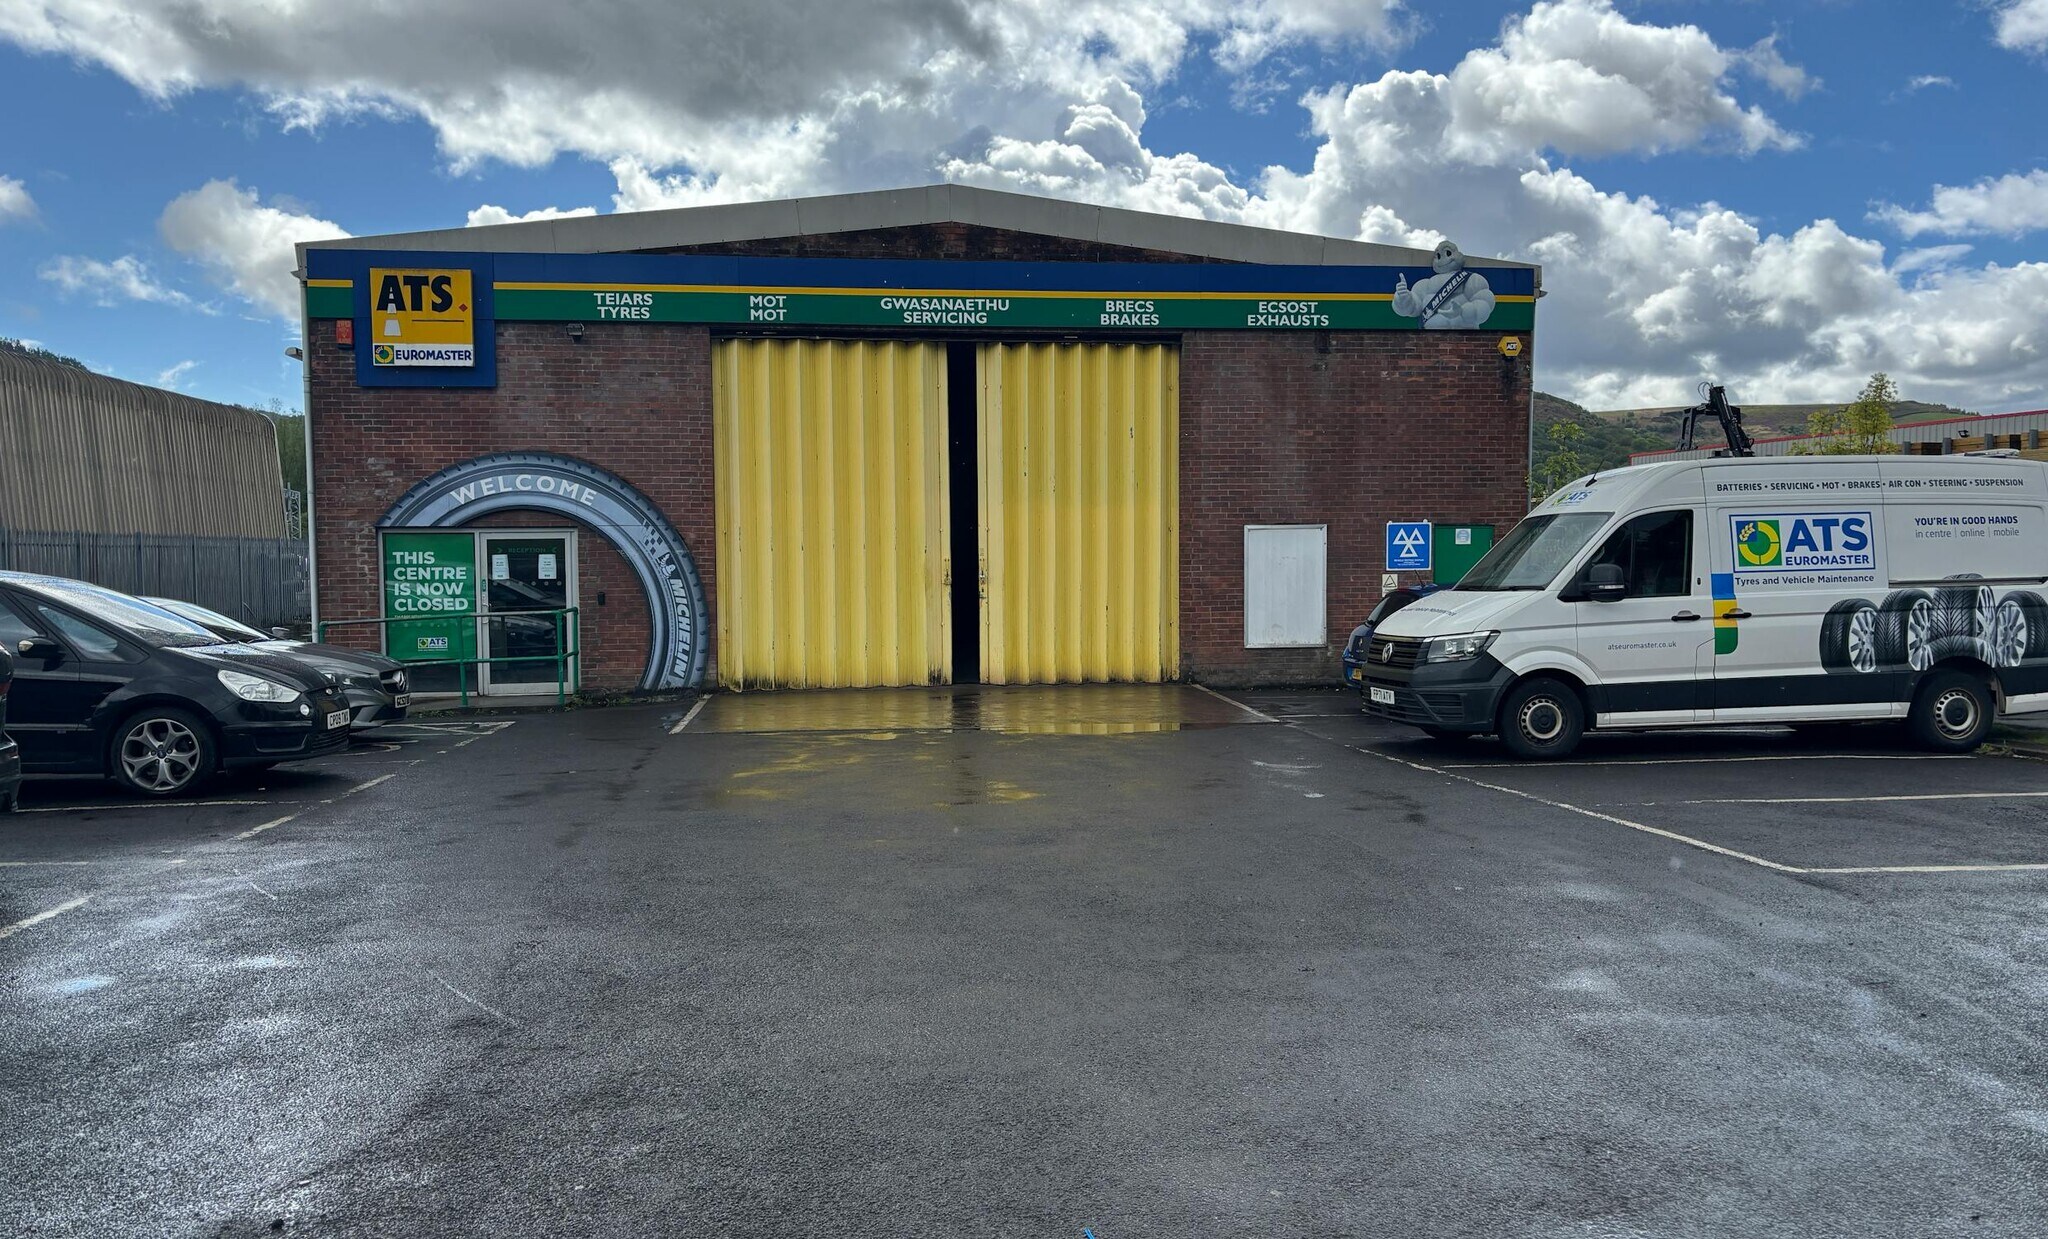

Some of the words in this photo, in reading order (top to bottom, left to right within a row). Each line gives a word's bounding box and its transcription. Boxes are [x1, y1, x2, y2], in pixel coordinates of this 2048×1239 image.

[376, 275, 453, 314] ATS
[1431, 271, 1468, 309] MICHELIN
[594, 292, 653, 305] TEIARS
[750, 295, 787, 308] MOT
[880, 297, 1010, 311] GWASANAETHU
[597, 306, 651, 319] TYRES
[1105, 300, 1154, 313] BRECS
[1258, 301, 1318, 313] ECSOST
[750, 309, 787, 321] MOT
[903, 312, 988, 324] SERVICING
[1100, 313, 1160, 326] BRAKES
[1247, 314, 1329, 326] EXHAUSTS
[395, 349, 473, 361] EUROMASTER
[450, 474, 597, 506] WELCOME
[1716, 483, 1762, 491] BATTERIES
[1770, 482, 1815, 490] SERVICING
[1822, 481, 1840, 490] MOT
[1848, 480, 1881, 489] BRAKES
[1888, 480, 1903, 488] AIR
[1904, 479, 1921, 488] CON
[1928, 479, 1968, 487] STEERING
[1975, 478, 2024, 487] SUSPENSION
[1914, 517, 1948, 526] YOU'RE
[1950, 517, 1960, 525] IN
[1962, 516, 1986, 525] GOOD
[1988, 515, 2018, 524] HANDS
[1785, 518, 1869, 552] ATS
[1915, 529, 1924, 538] in
[1925, 529, 1952, 538] centre
[1960, 528, 1985, 538] online
[1993, 527, 2020, 536] mobile
[392, 551, 435, 564] THIS
[1785, 554, 1870, 566] EUROMASTER
[393, 567, 467, 580] CENTRE
[1735, 576, 1760, 587] Tyres
[1762, 576, 1780, 585] and
[1782, 575, 1815, 584] Vehicle
[1817, 574, 1875, 583] Maintenance
[394, 582, 411, 596] IS
[416, 582, 464, 596] NOW
[394, 597, 469, 612] CLOSED
[670, 578, 691, 679] MICHELIN
[429, 638, 447, 646] ATS
[1607, 640, 1678, 650] atseuromaster.co.uk
